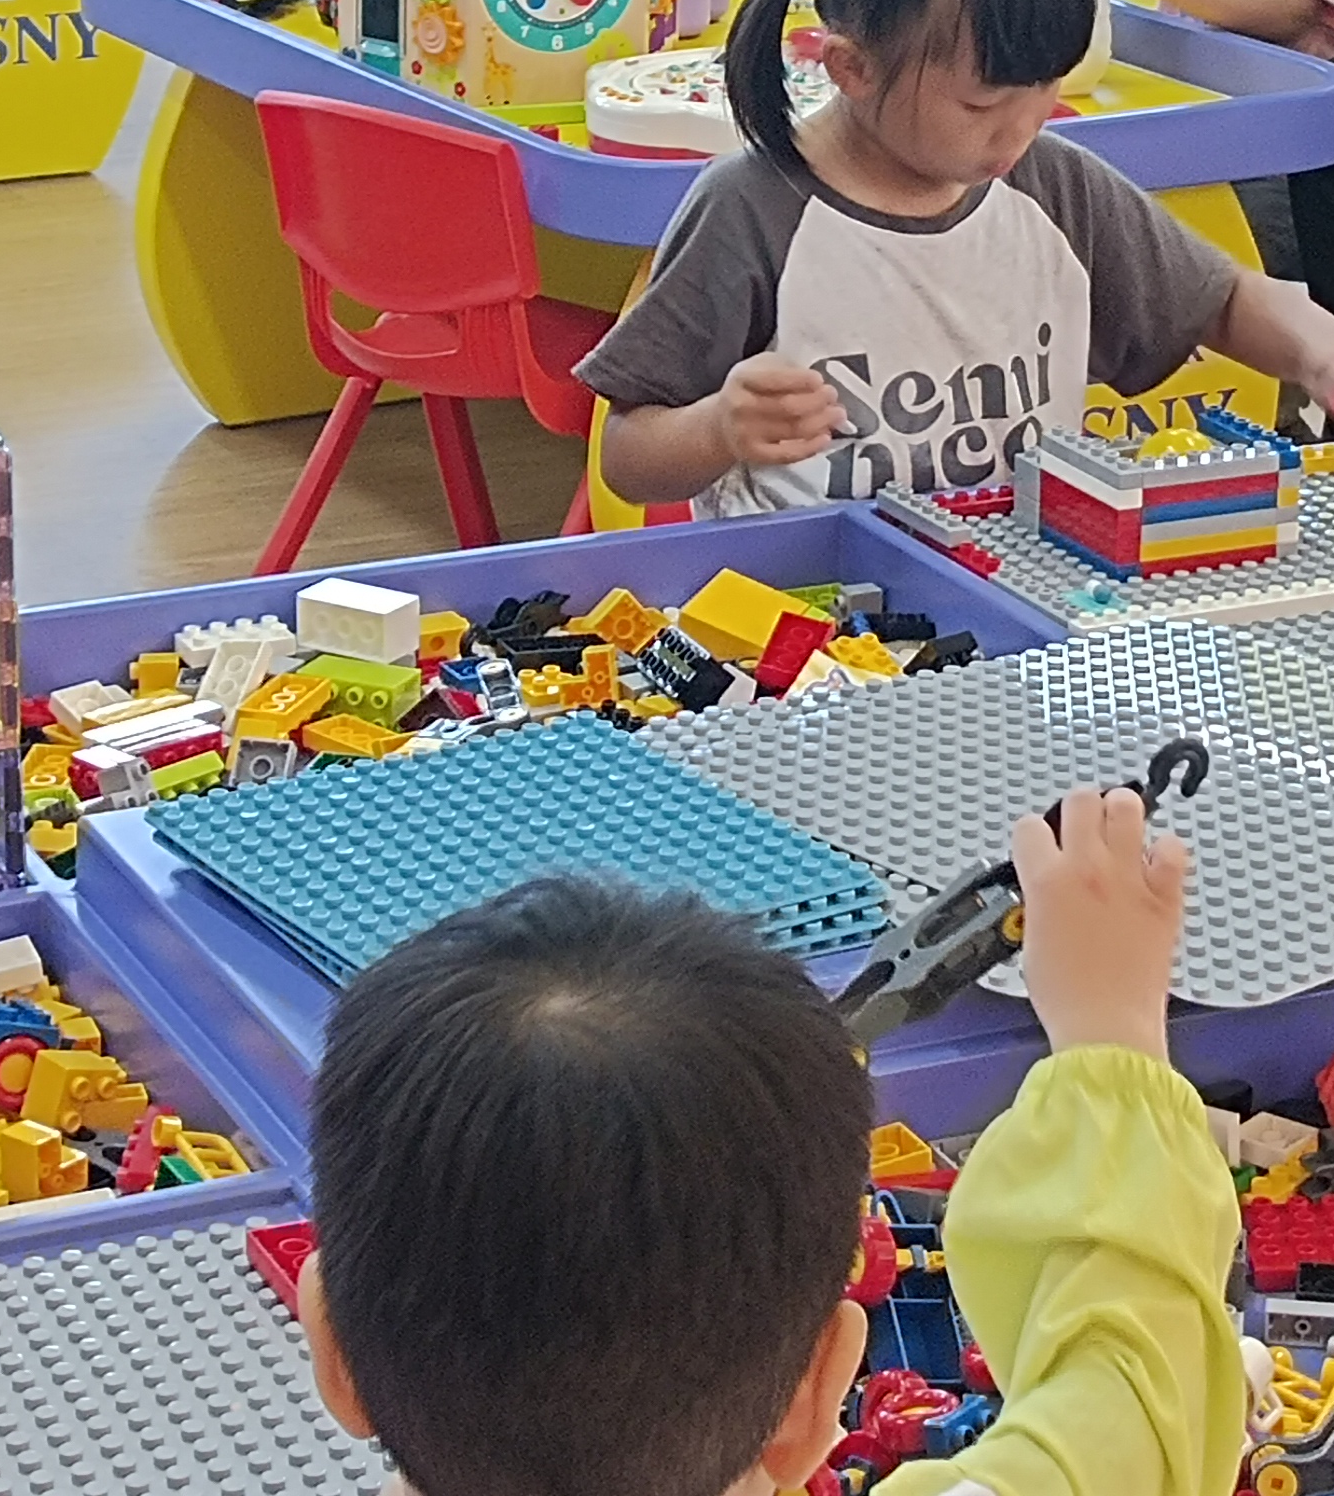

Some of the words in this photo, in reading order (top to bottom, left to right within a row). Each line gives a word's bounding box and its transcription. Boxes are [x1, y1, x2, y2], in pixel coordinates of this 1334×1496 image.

[520, 25, 529, 37] 7
[585, 22, 594, 35] 5
[552, 35, 563, 50] 6
